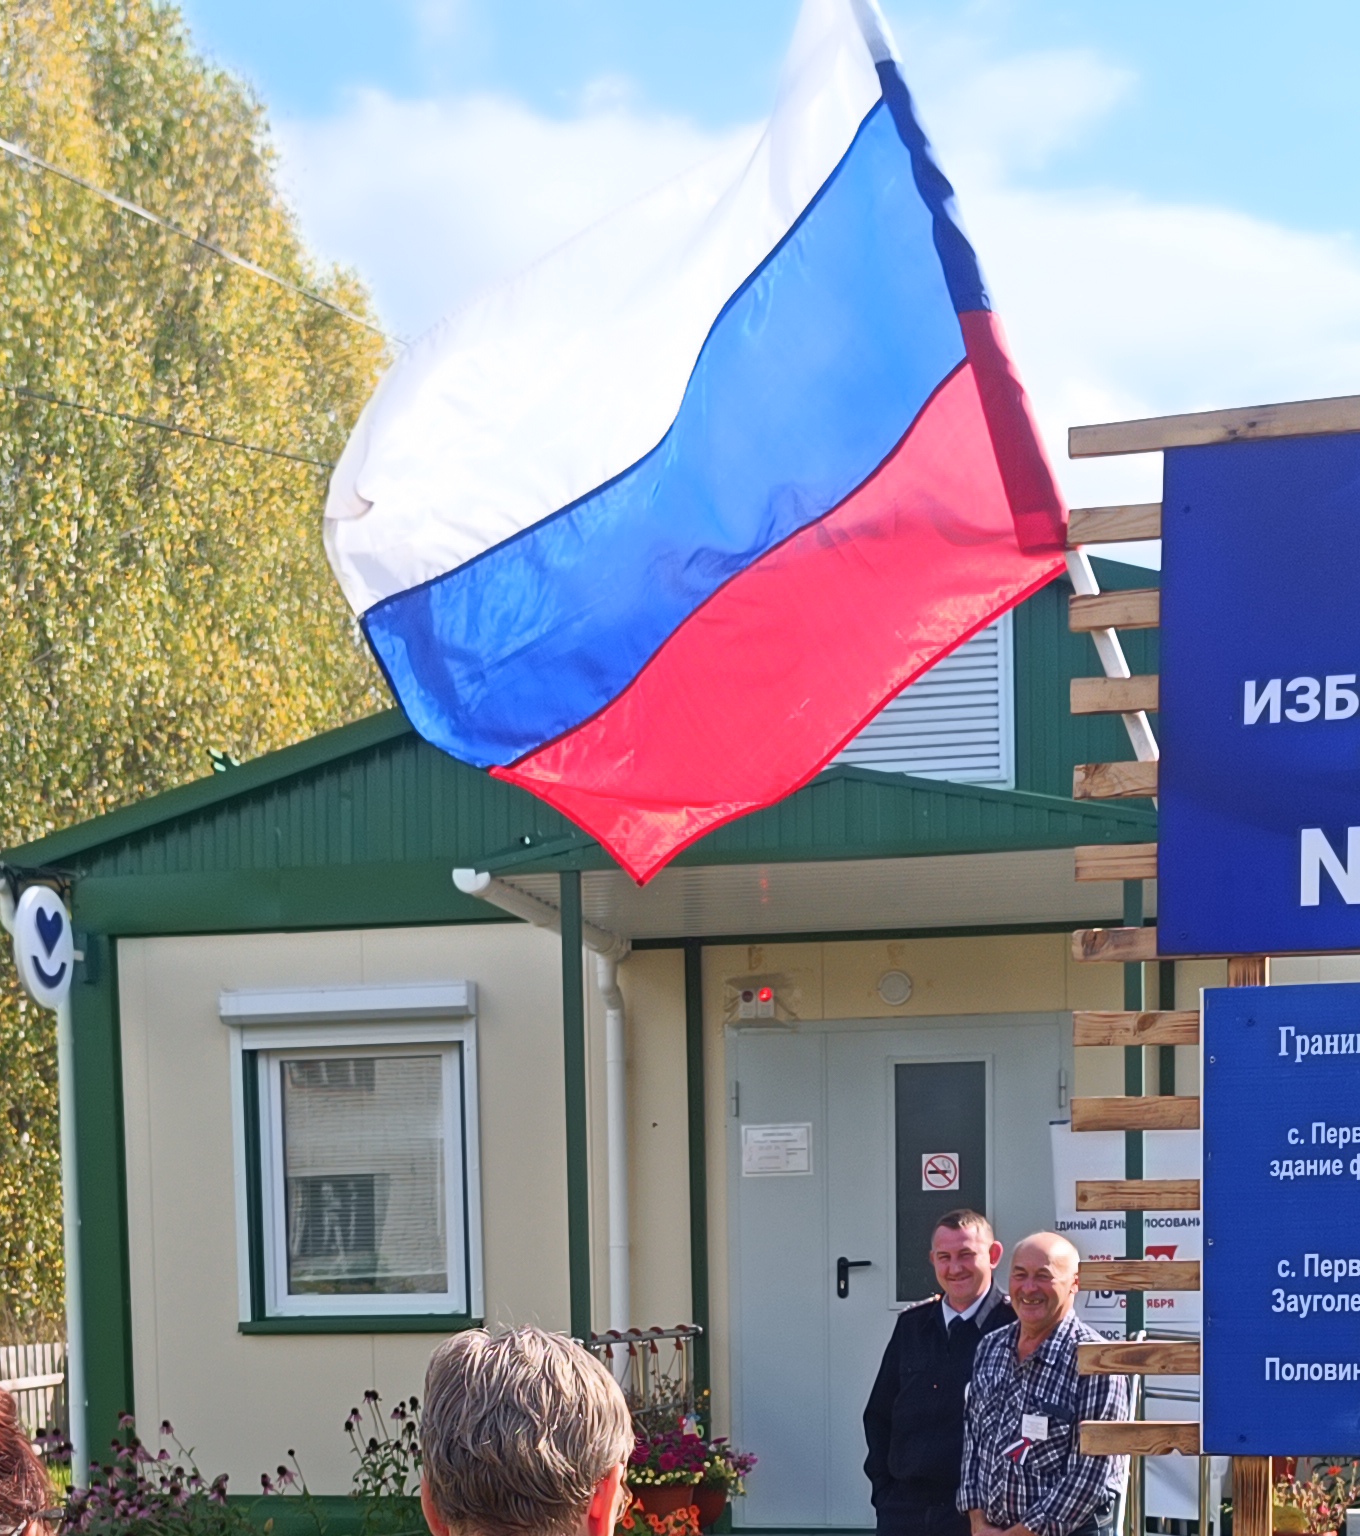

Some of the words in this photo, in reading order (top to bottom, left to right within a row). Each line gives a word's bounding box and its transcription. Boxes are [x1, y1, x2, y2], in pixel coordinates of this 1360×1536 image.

[1287, 1127, 1305, 1145] с.
[1269, 1158, 1344, 1181] здание
[1277, 1259, 1296, 1278] с.
[1120, 1299, 1174, 1309] СЯБРЯ
